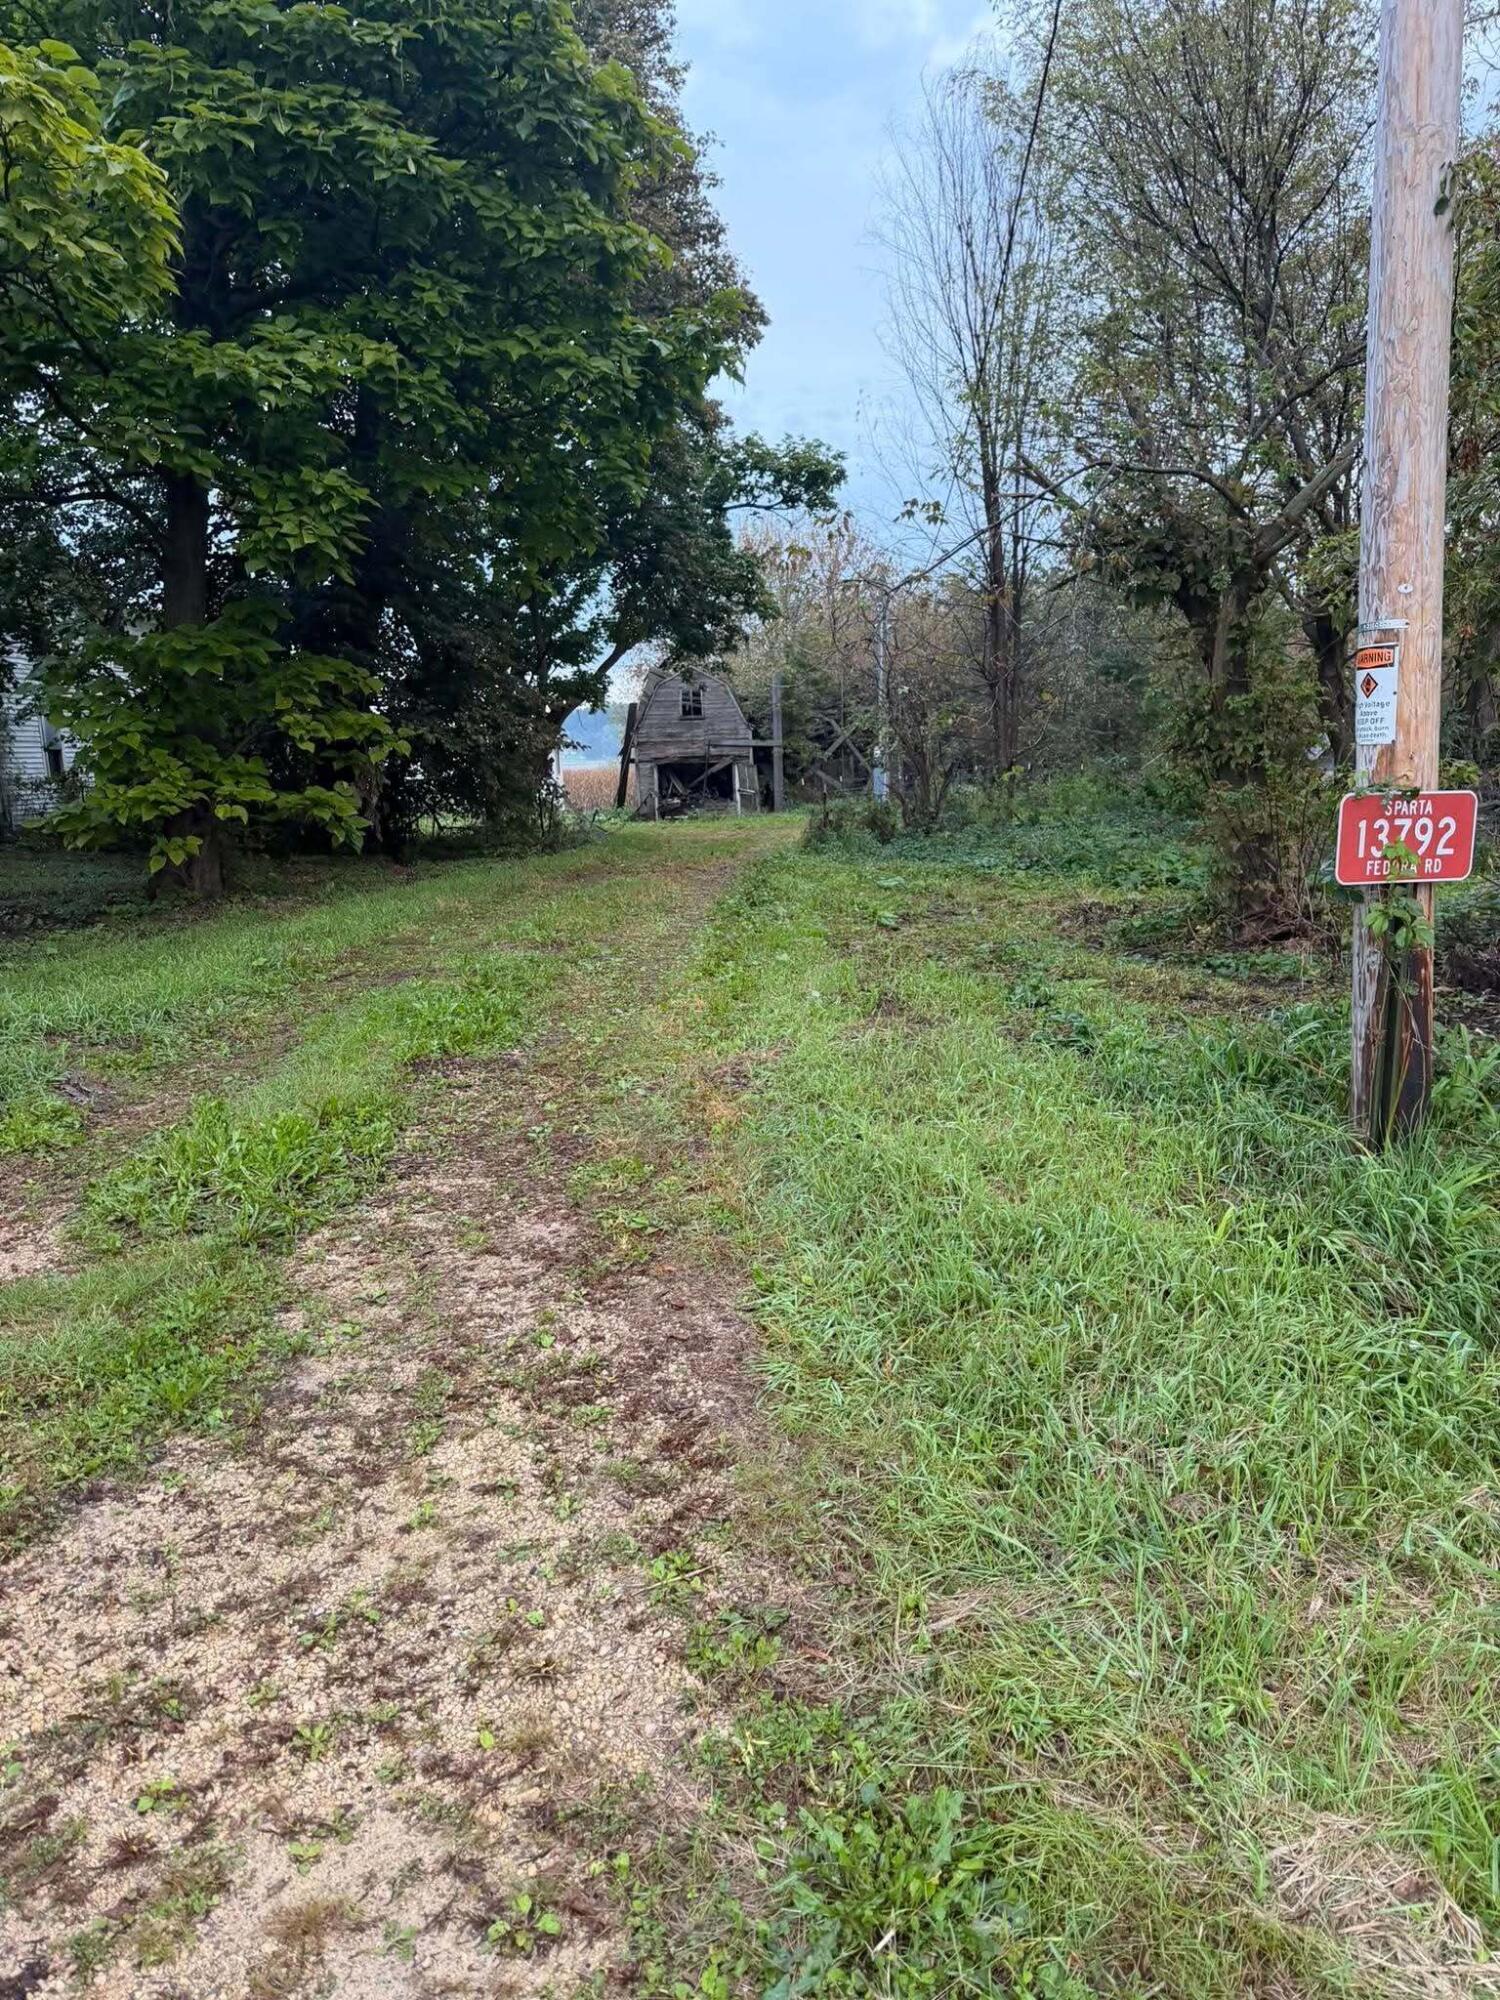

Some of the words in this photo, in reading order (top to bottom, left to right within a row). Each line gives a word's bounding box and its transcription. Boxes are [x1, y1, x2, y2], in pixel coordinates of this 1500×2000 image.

[1358, 651, 1391, 664] ARNING
[1369, 717, 1385, 725] OFF
[1385, 799, 1433, 816] SPARTA
[1357, 816, 1457, 858] 13792
[1424, 858, 1442, 873] RD
